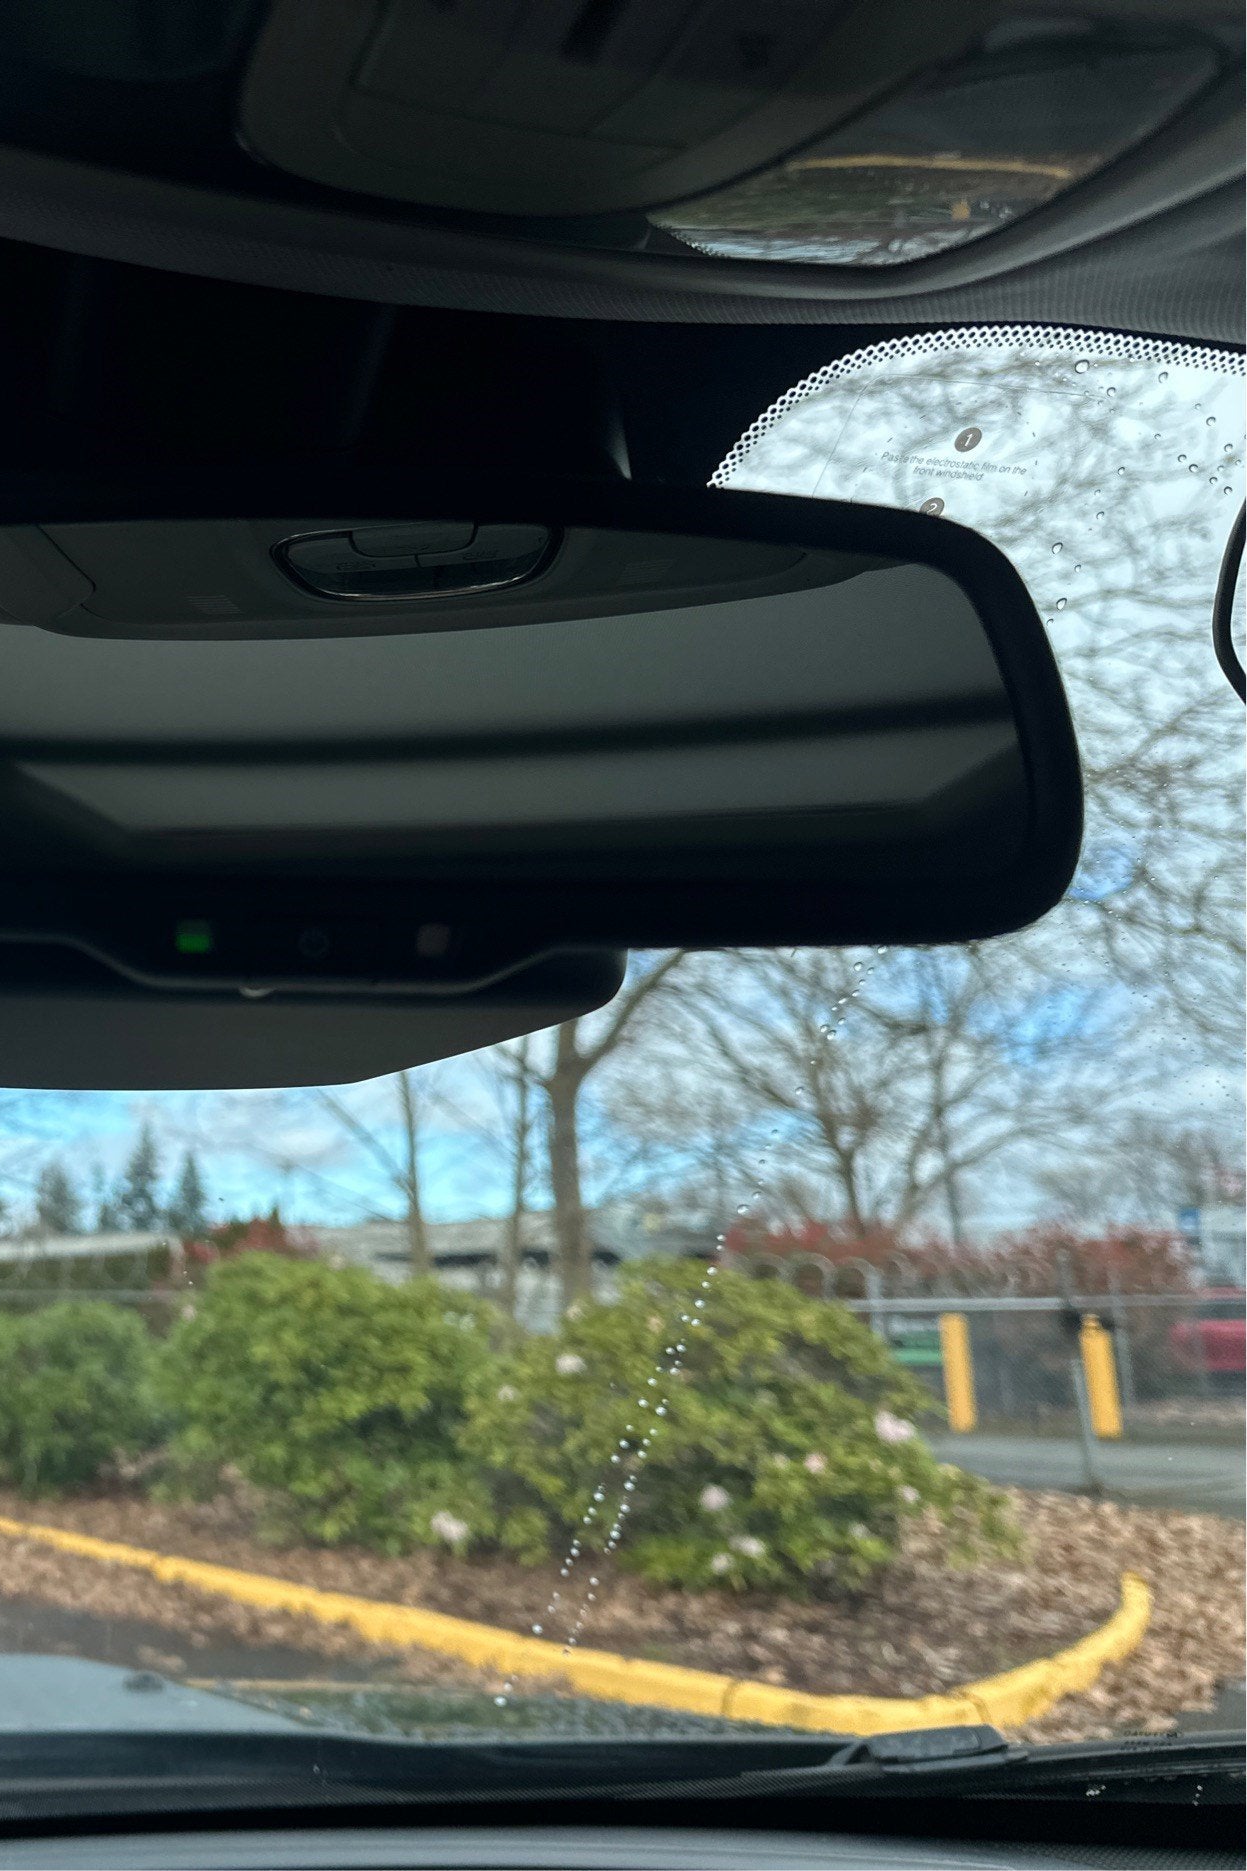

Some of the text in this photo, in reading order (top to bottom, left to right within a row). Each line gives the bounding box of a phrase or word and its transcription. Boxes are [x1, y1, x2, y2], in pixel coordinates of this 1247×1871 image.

[964, 433, 973, 447] 1
[881, 451, 1027, 475] Paste the electrostatic film on the
[913, 466, 984, 481] front windshield
